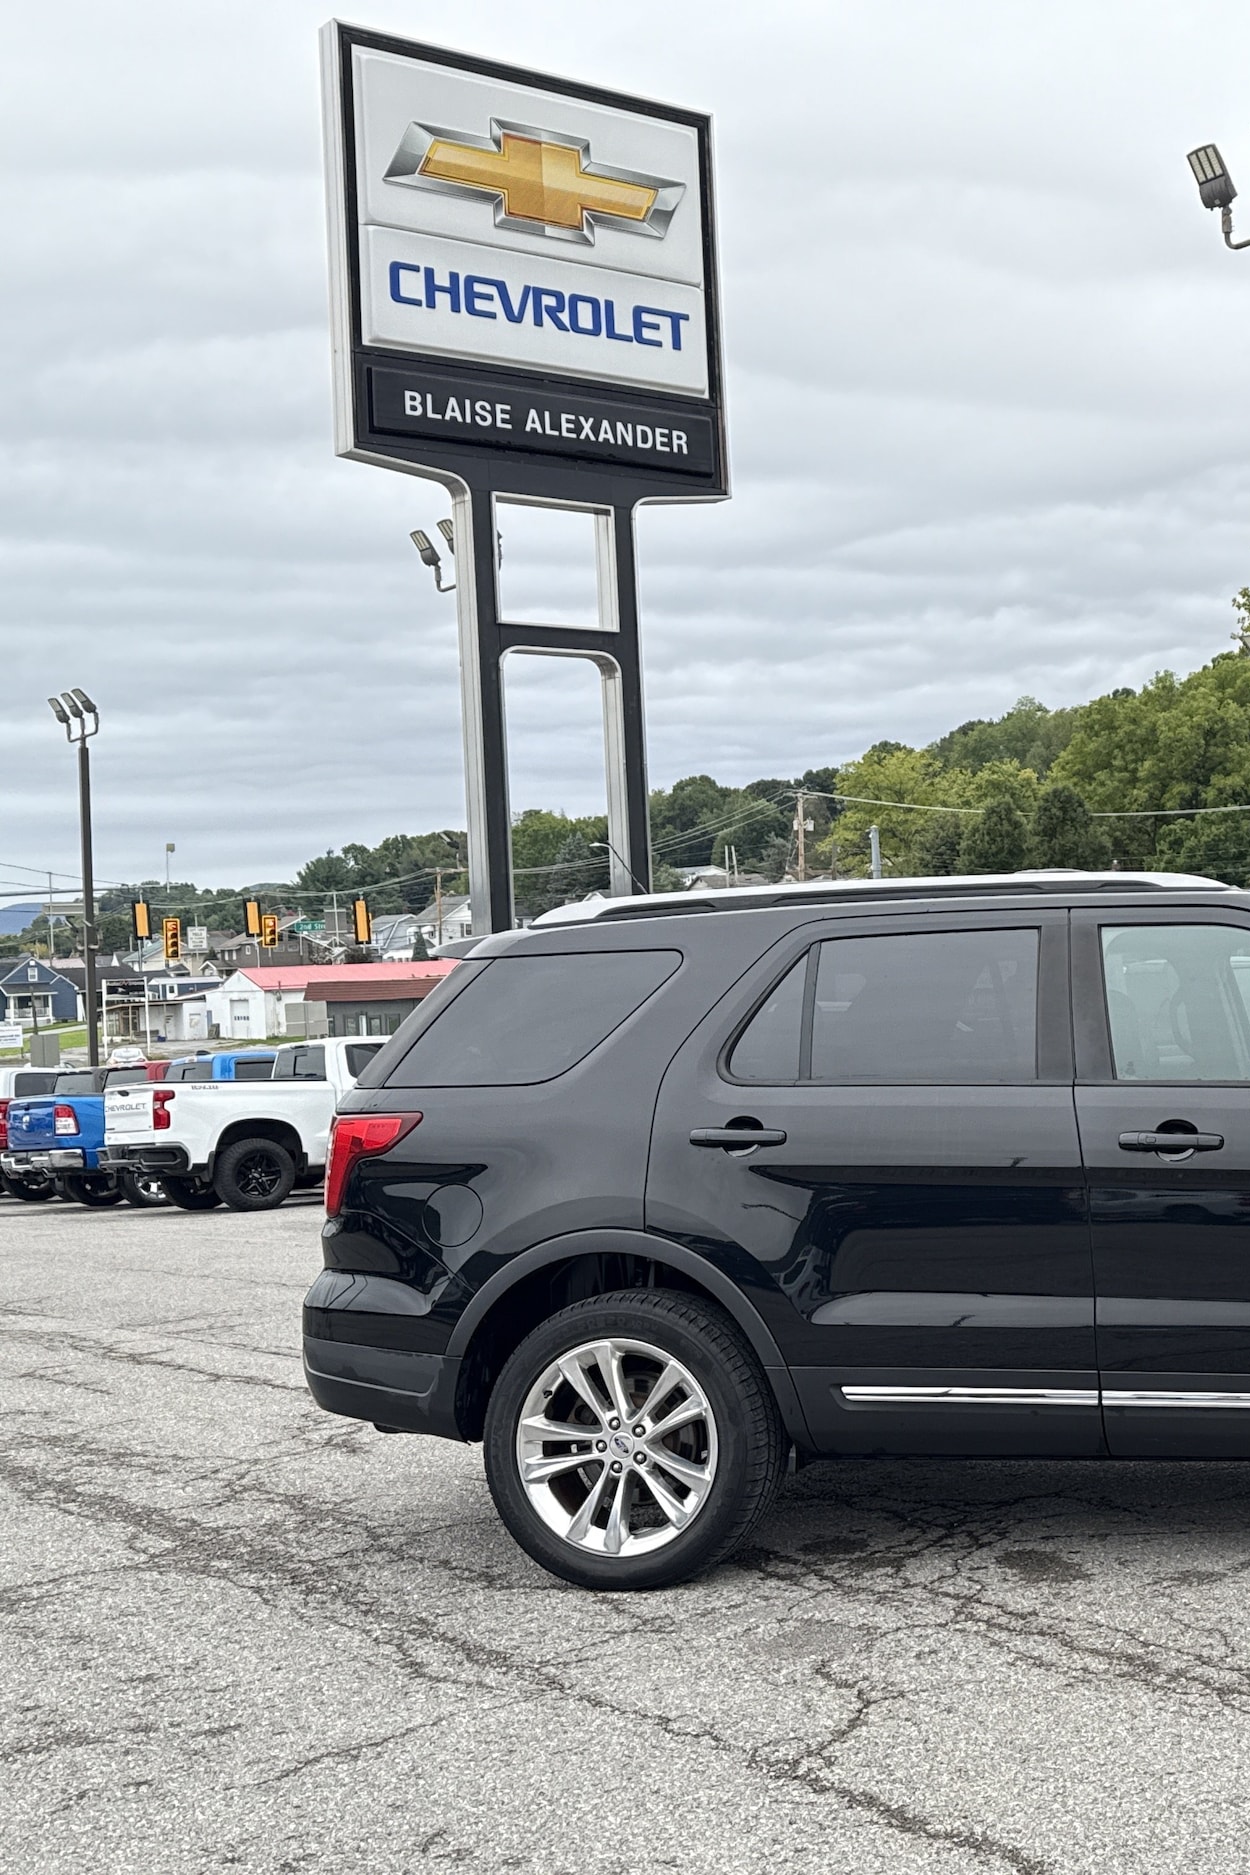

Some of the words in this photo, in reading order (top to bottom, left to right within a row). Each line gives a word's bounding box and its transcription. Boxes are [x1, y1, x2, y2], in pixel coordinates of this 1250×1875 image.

[389, 261, 689, 350] CHEVROLET
[404, 390, 513, 430] BLAISE
[525, 408, 689, 455] ALEXANDER
